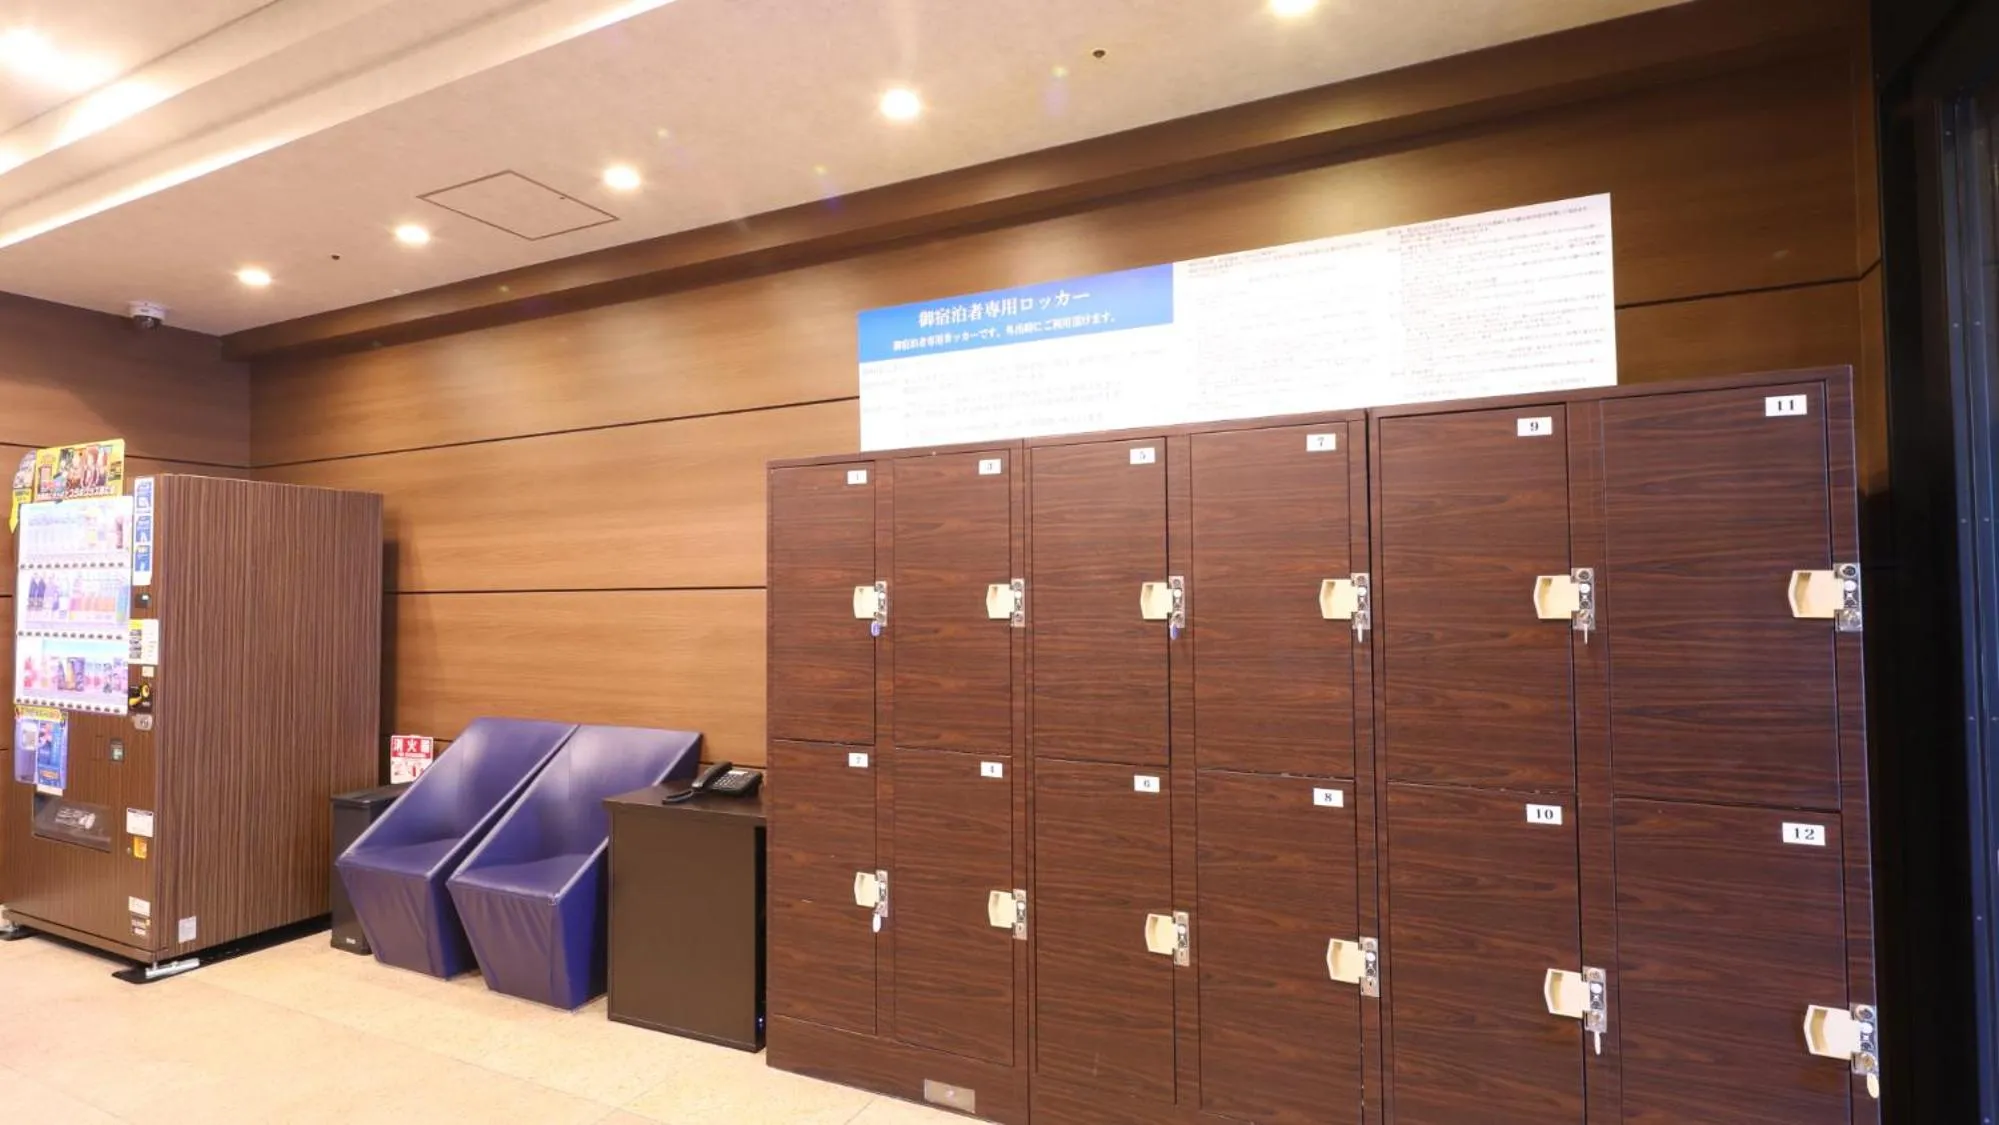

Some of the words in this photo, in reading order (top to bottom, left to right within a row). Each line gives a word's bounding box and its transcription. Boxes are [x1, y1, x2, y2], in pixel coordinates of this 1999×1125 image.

[918, 289, 1090, 328] 御宿泊者専用ロッカー
[1776, 398, 1796, 413] 11
[1529, 420, 1540, 433] 9
[1316, 436, 1325, 448] 7
[1143, 779, 1152, 790] 6
[1323, 792, 1333, 803] 8
[1535, 807, 1555, 821] 10
[1793, 826, 1816, 841] 12
